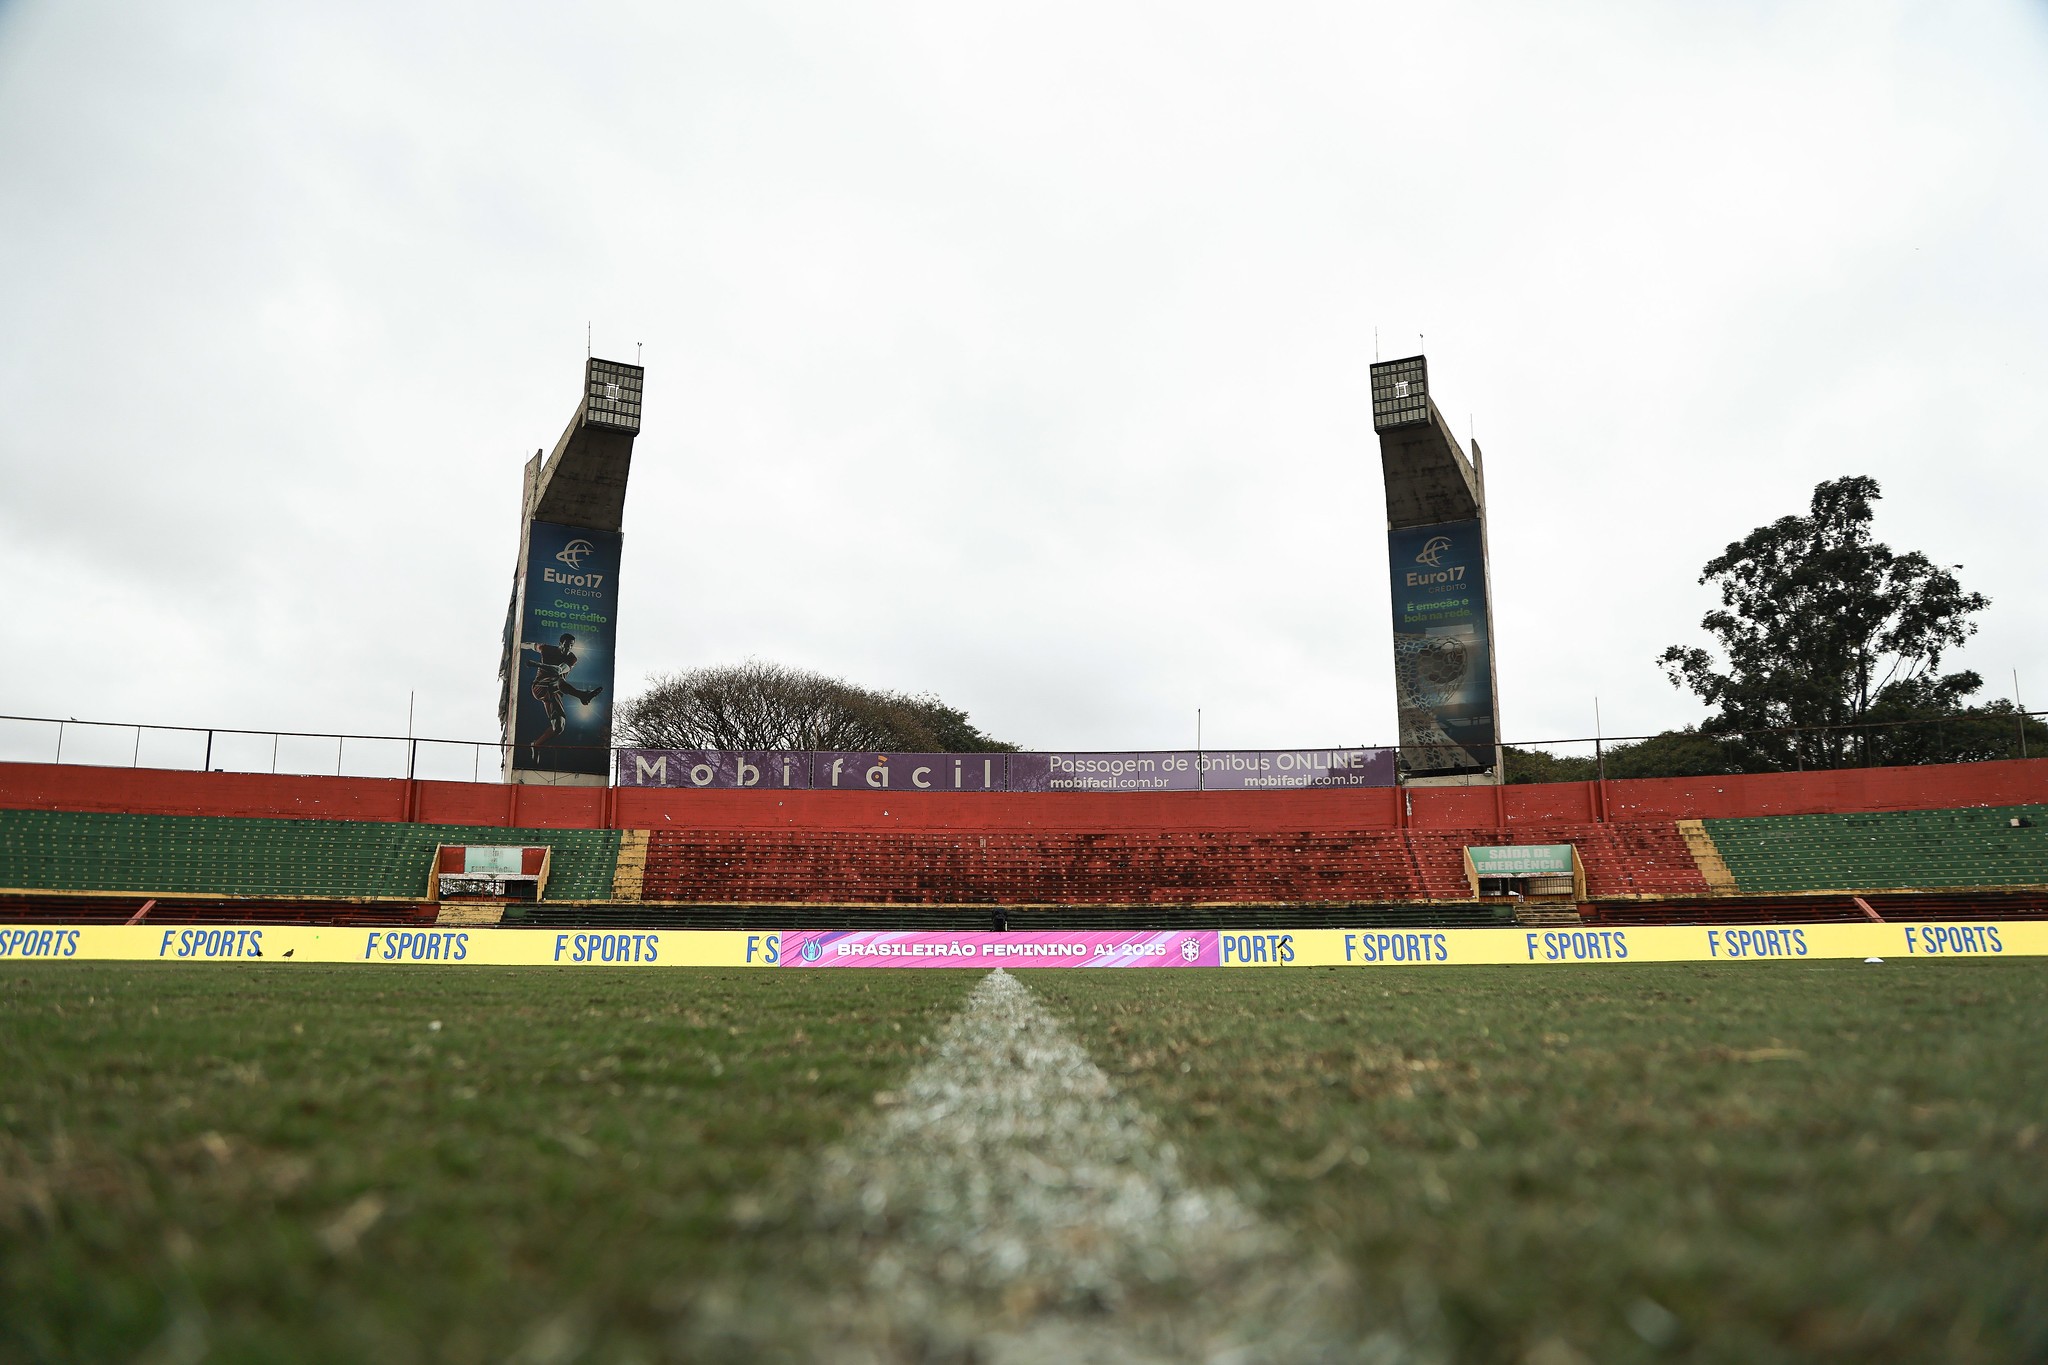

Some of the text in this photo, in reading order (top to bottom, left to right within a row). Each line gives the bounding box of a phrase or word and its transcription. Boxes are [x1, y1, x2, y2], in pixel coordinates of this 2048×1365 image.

[543, 567, 603, 589] Euro17
[1406, 566, 1465, 587] Euro17
[564, 587, 602, 598] CRÉDITO
[554, 599, 590, 612] Com o
[1407, 601, 1415, 612] É
[1416, 598, 1460, 611] emoção
[534, 608, 607, 624] nosso crédito
[1404, 612, 1428, 623] bola
[1429, 612, 1443, 620] na
[541, 619, 600, 633] em campo.
[1050, 751, 1364, 776] Passagem de ônibus ONLINE
[1050, 776, 1170, 788] mobifacil.com.br
[1244, 773, 1365, 787] mobifacil.com.br
[1489, 847, 1551, 859] SAÍDA DE
[1477, 859, 1565, 871] EMERGÊNCIA
[837, 941, 1167, 957] BRASILEIRÃO FEMININO A1 2025
[1223, 935, 1295, 962] PORTS
